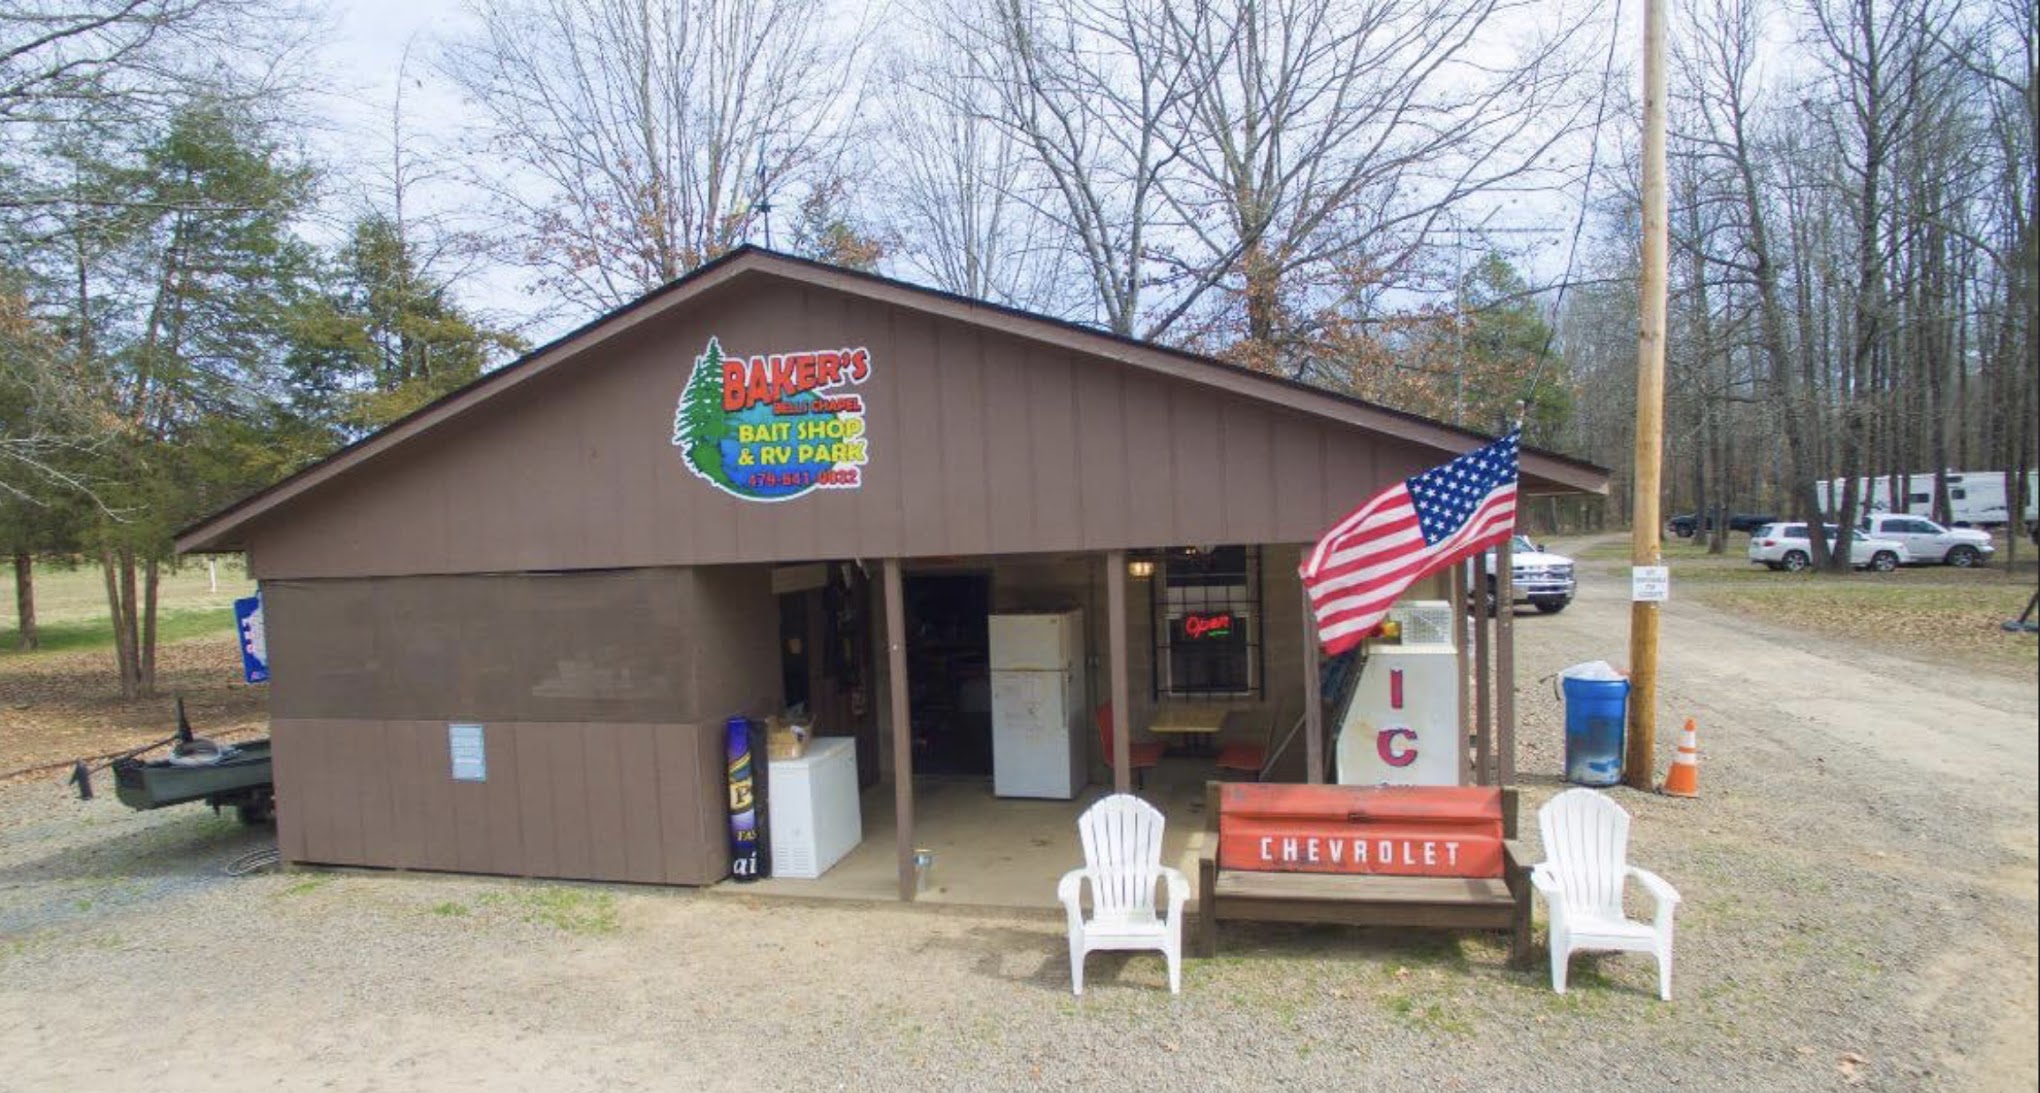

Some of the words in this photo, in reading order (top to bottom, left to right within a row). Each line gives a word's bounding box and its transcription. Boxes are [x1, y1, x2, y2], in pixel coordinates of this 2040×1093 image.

[722, 349, 868, 411] BAKER'S
[813, 397, 861, 413] CHAPEL
[738, 423, 791, 442] BAIT
[797, 418, 862, 440] SHOP
[738, 448, 755, 465] &
[760, 446, 791, 465] RV
[798, 441, 865, 464] PARK
[1185, 614, 1231, 639] Open
[1260, 836, 1460, 867] CHEVROLET
